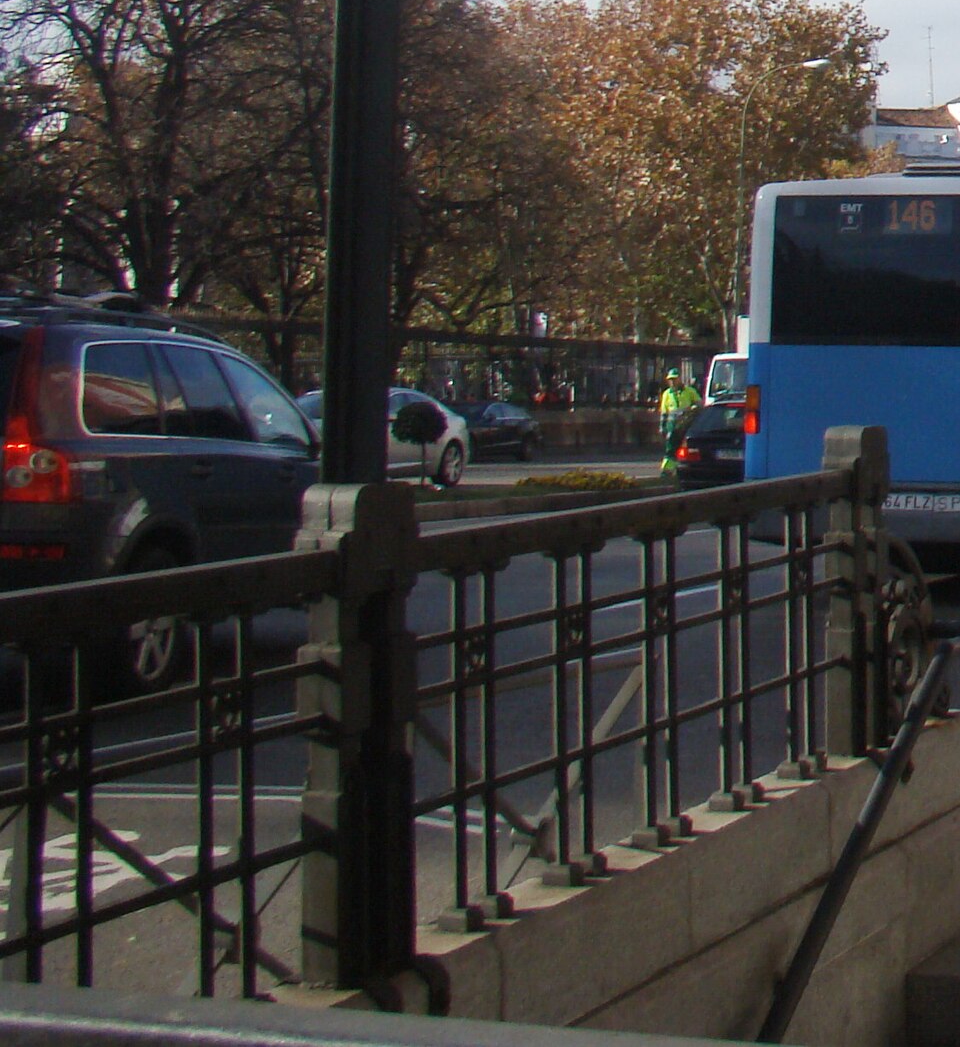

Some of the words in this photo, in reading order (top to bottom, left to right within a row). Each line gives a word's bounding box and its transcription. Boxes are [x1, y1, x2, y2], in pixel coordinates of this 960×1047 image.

[840, 203, 863, 213] EMT
[889, 200, 935, 230] 146
[905, 495, 931, 509] FLZ
